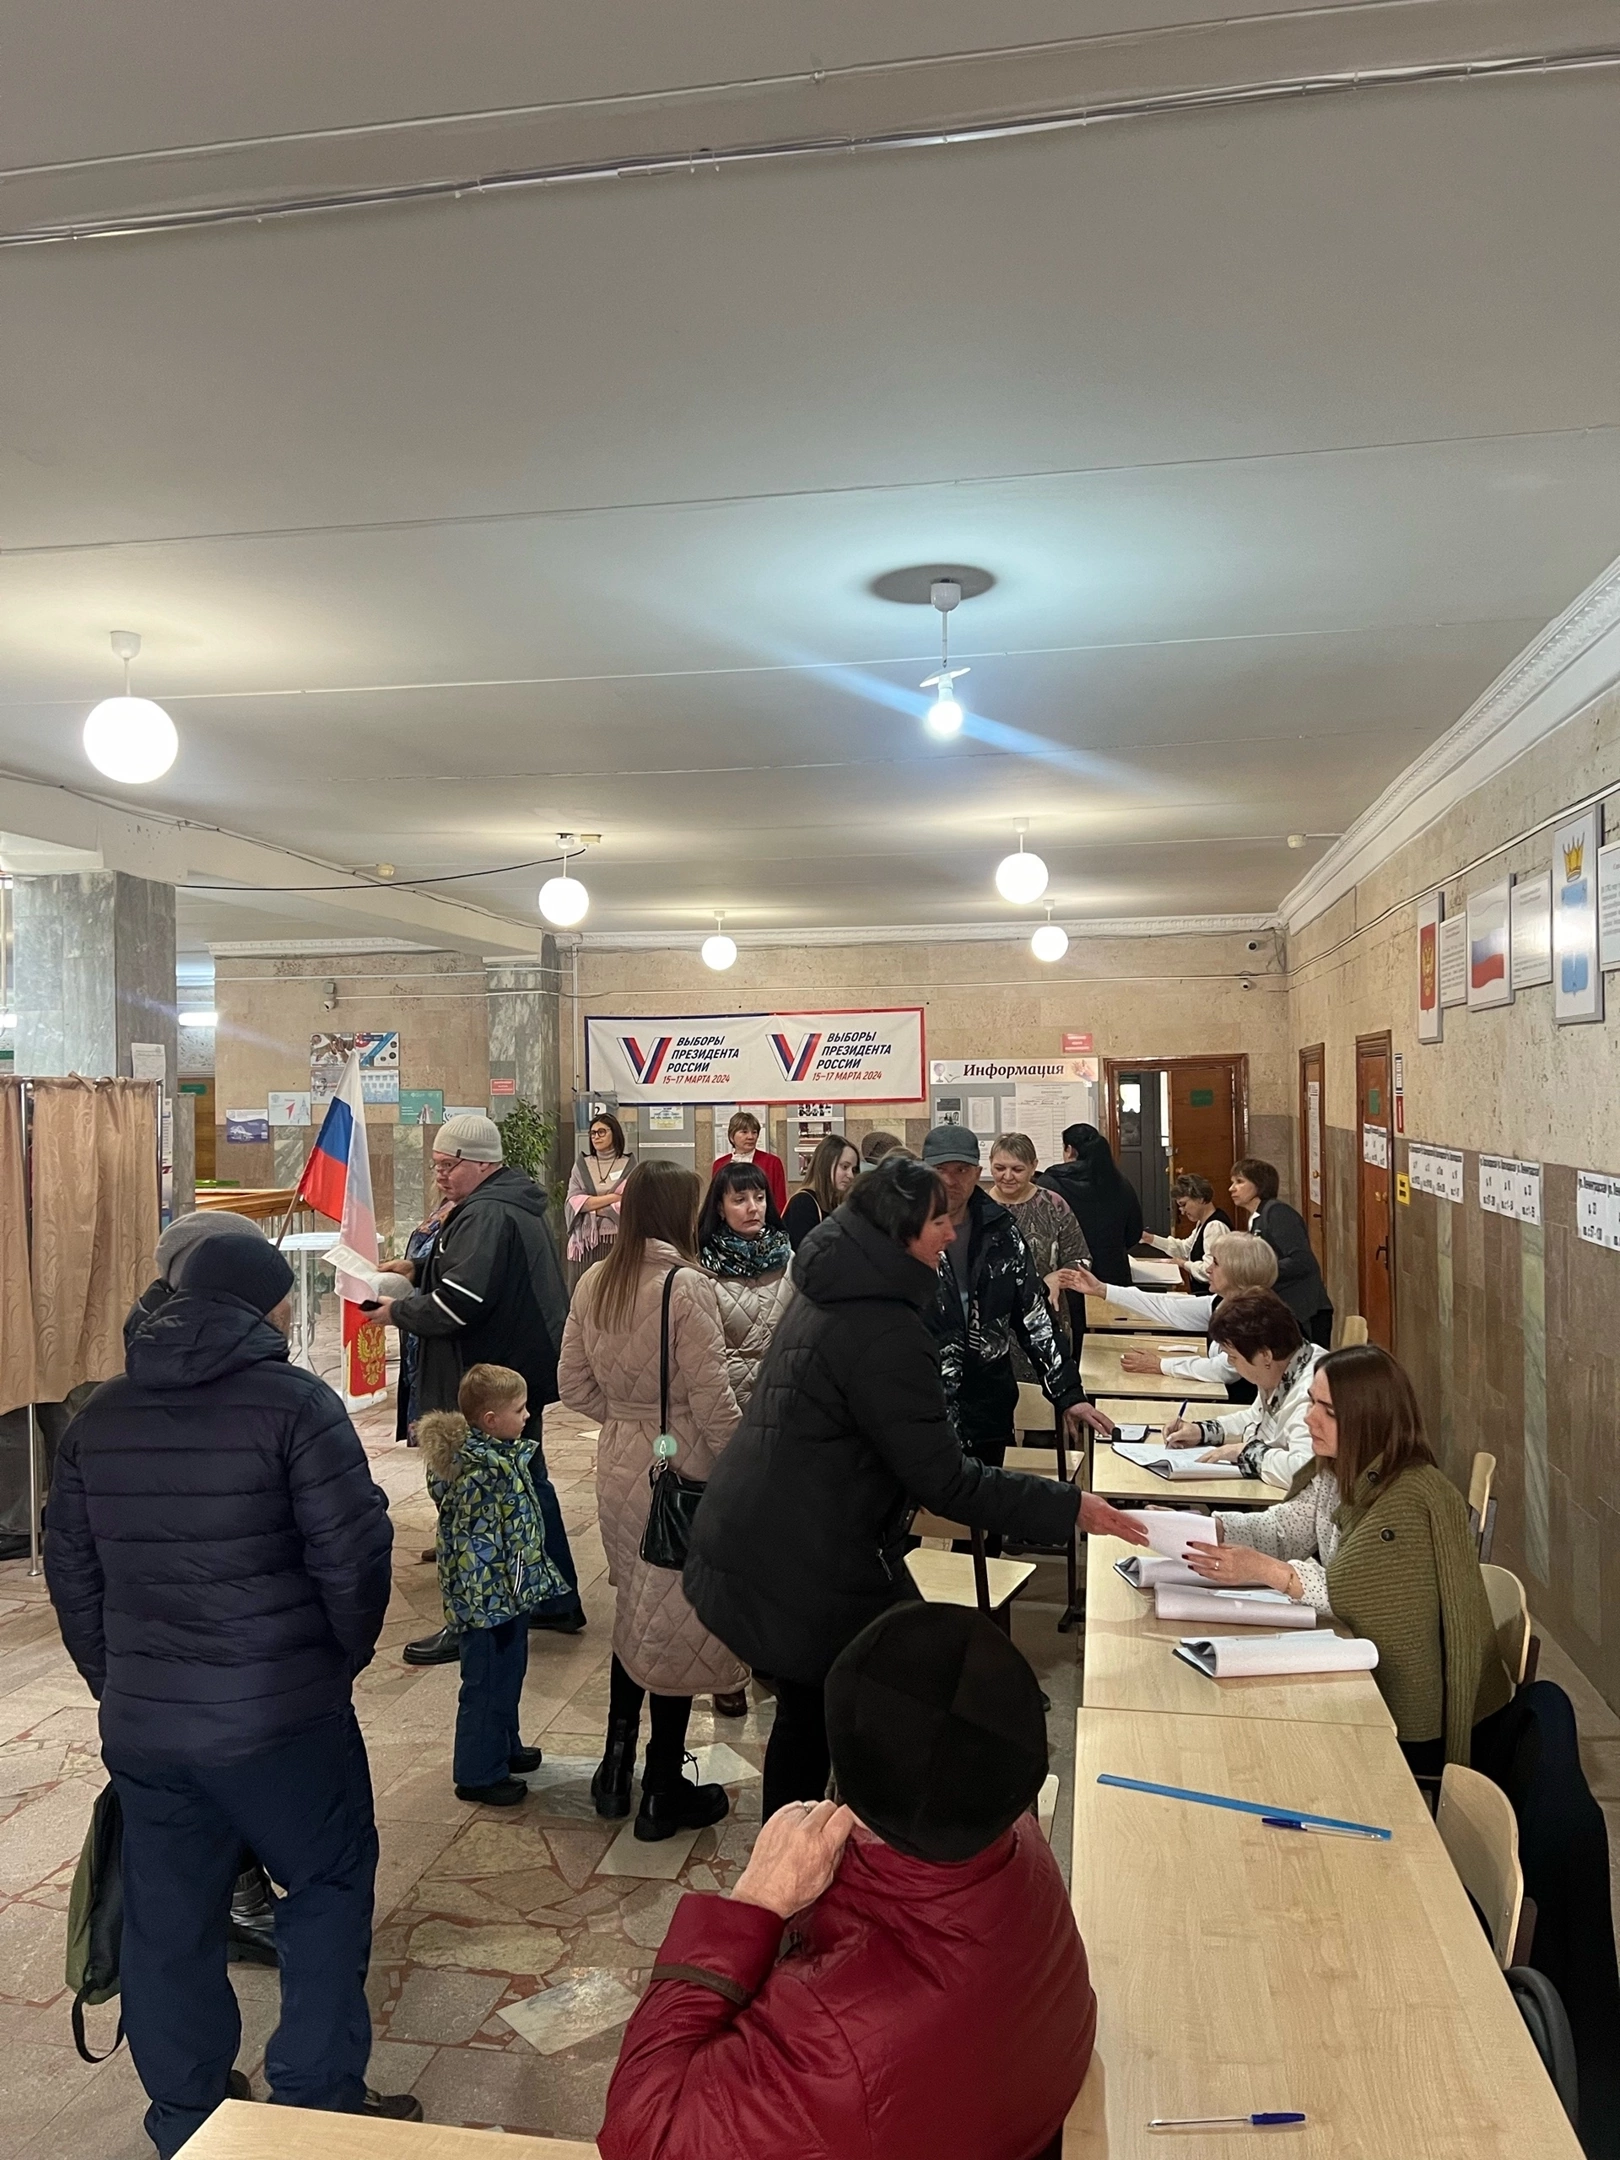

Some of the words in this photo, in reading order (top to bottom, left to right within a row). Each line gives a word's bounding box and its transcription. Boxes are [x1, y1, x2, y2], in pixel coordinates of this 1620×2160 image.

[676, 1035, 726, 1047] ВЫБОРЫ
[826, 1031, 877, 1043] ВЫБОРЫ
[671, 1048, 740, 1061] ПРЕЗИДЕНТА
[821, 1044, 892, 1057] ПРЕЗИДЕНТА
[666, 1062, 710, 1073] РОССИИ
[816, 1058, 862, 1070] РОССИИ
[835, 1071, 861, 1081] МАРТА
[862, 1070, 883, 1081] 2024
[963, 1063, 1065, 1079] Информация
[684, 1074, 710, 1084] МАРТА
[711, 1074, 731, 1084] 2024
